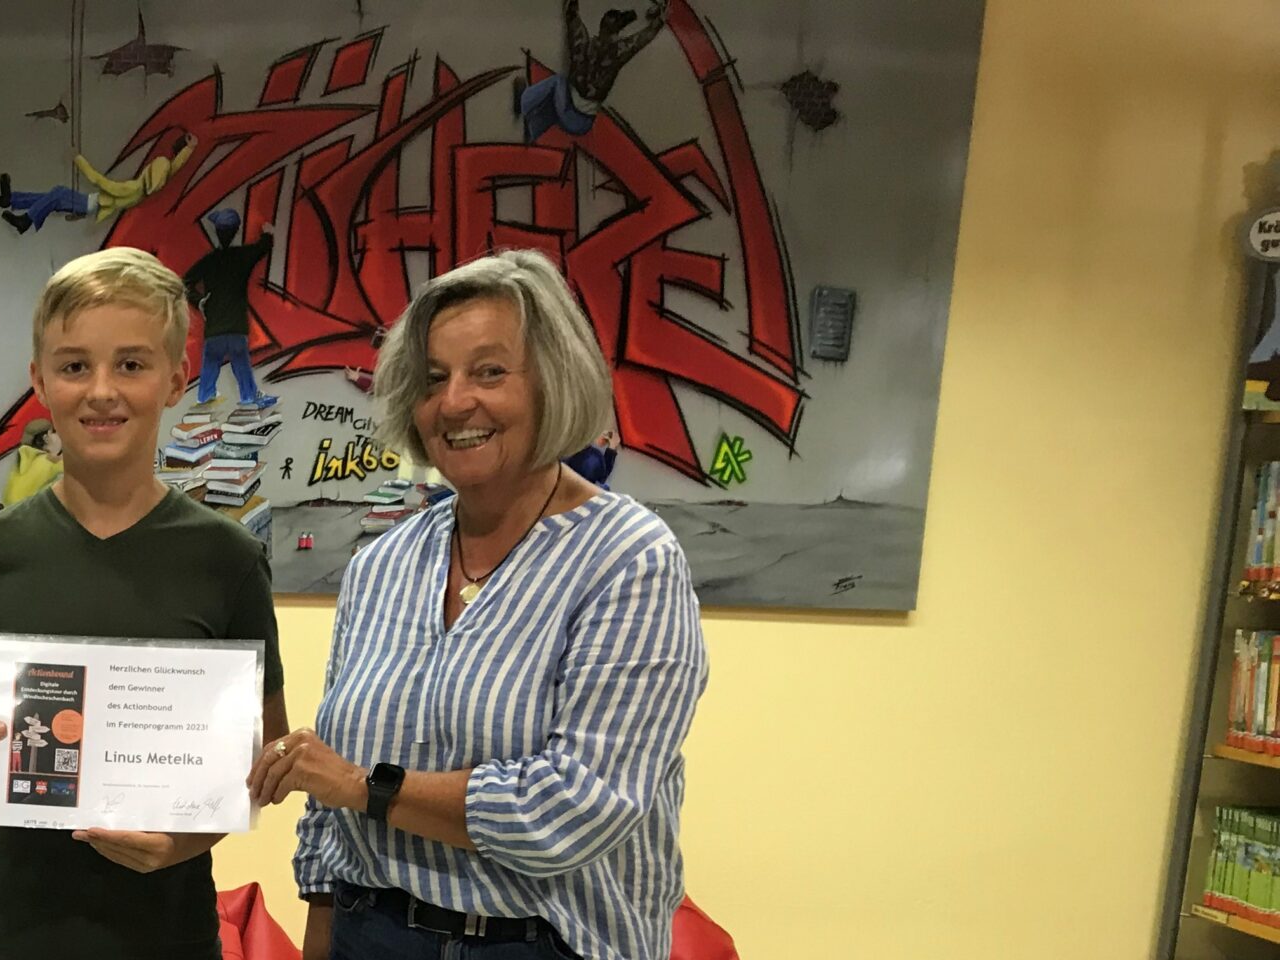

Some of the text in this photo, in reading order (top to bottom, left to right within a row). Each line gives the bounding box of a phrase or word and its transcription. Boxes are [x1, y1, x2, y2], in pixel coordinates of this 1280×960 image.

[302, 400, 354, 424] DREAM
[109, 664, 206, 676] Herzlichen Glückwunsch
[108, 683, 166, 693] dem Gewinner
[107, 702, 173, 712] des Actionbound
[118, 721, 184, 732] Ferienprogramm
[104, 750, 203, 766] Linus Metelka
